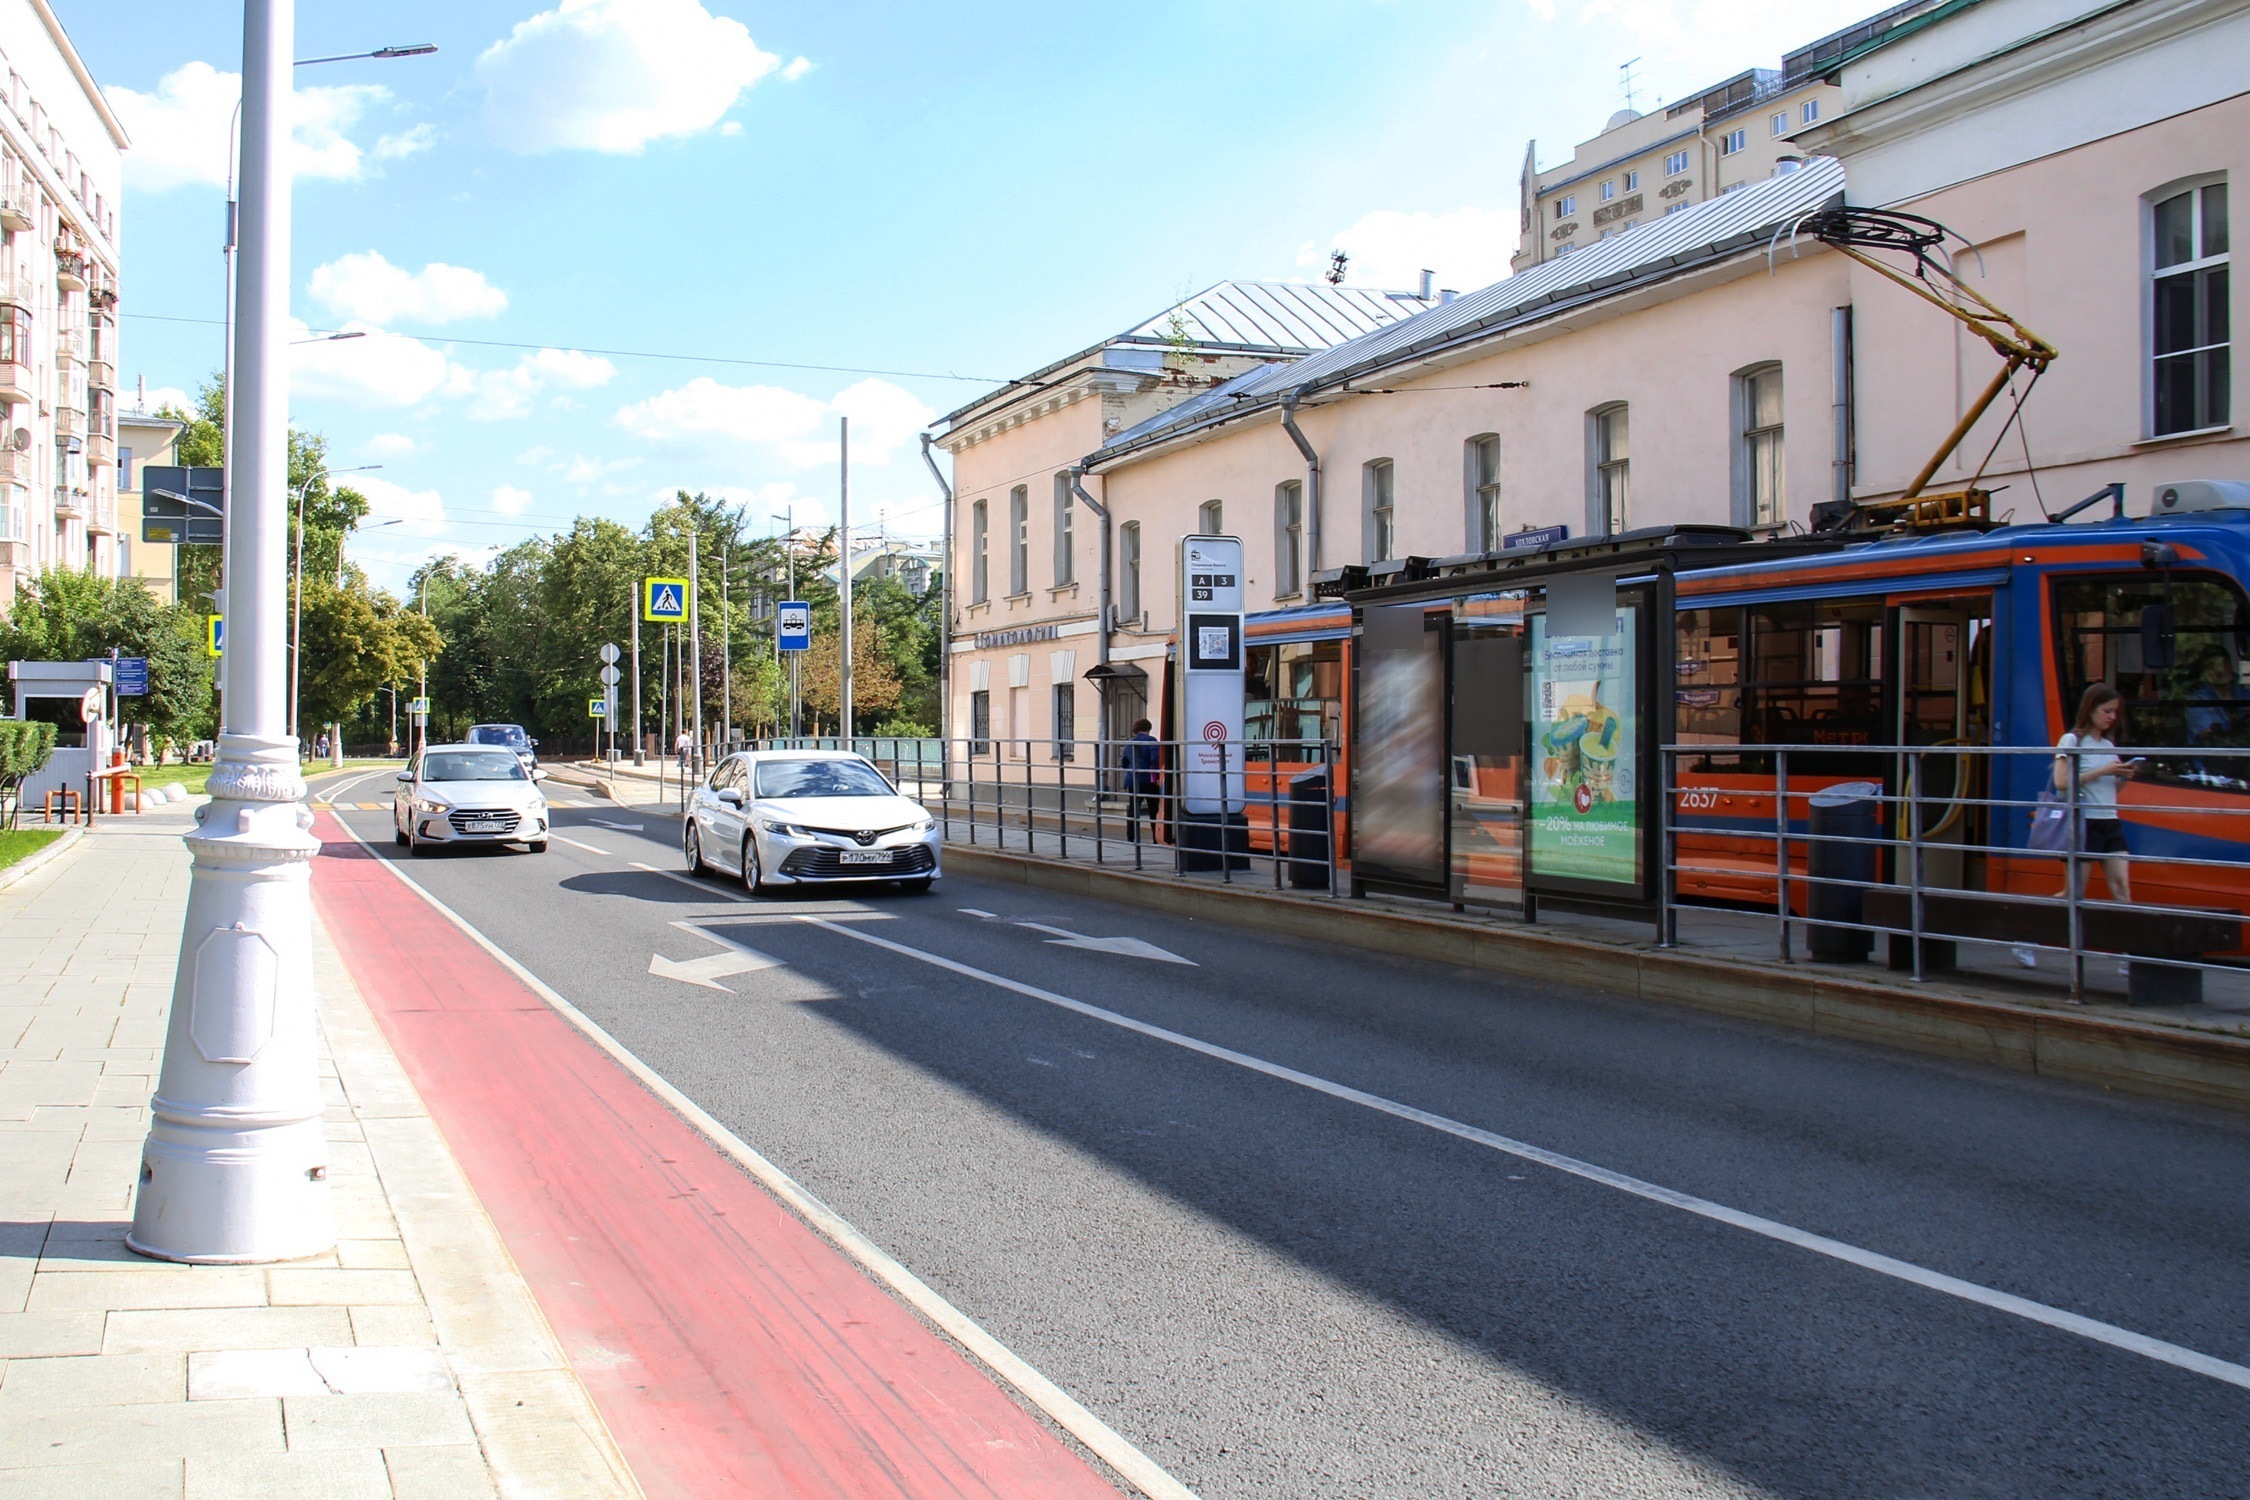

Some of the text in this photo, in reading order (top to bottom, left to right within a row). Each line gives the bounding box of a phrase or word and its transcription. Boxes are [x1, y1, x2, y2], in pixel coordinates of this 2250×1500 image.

[1221, 576, 1228, 586] 3
[1196, 590, 1208, 600] 39
[1680, 787, 1719, 808] 2637
